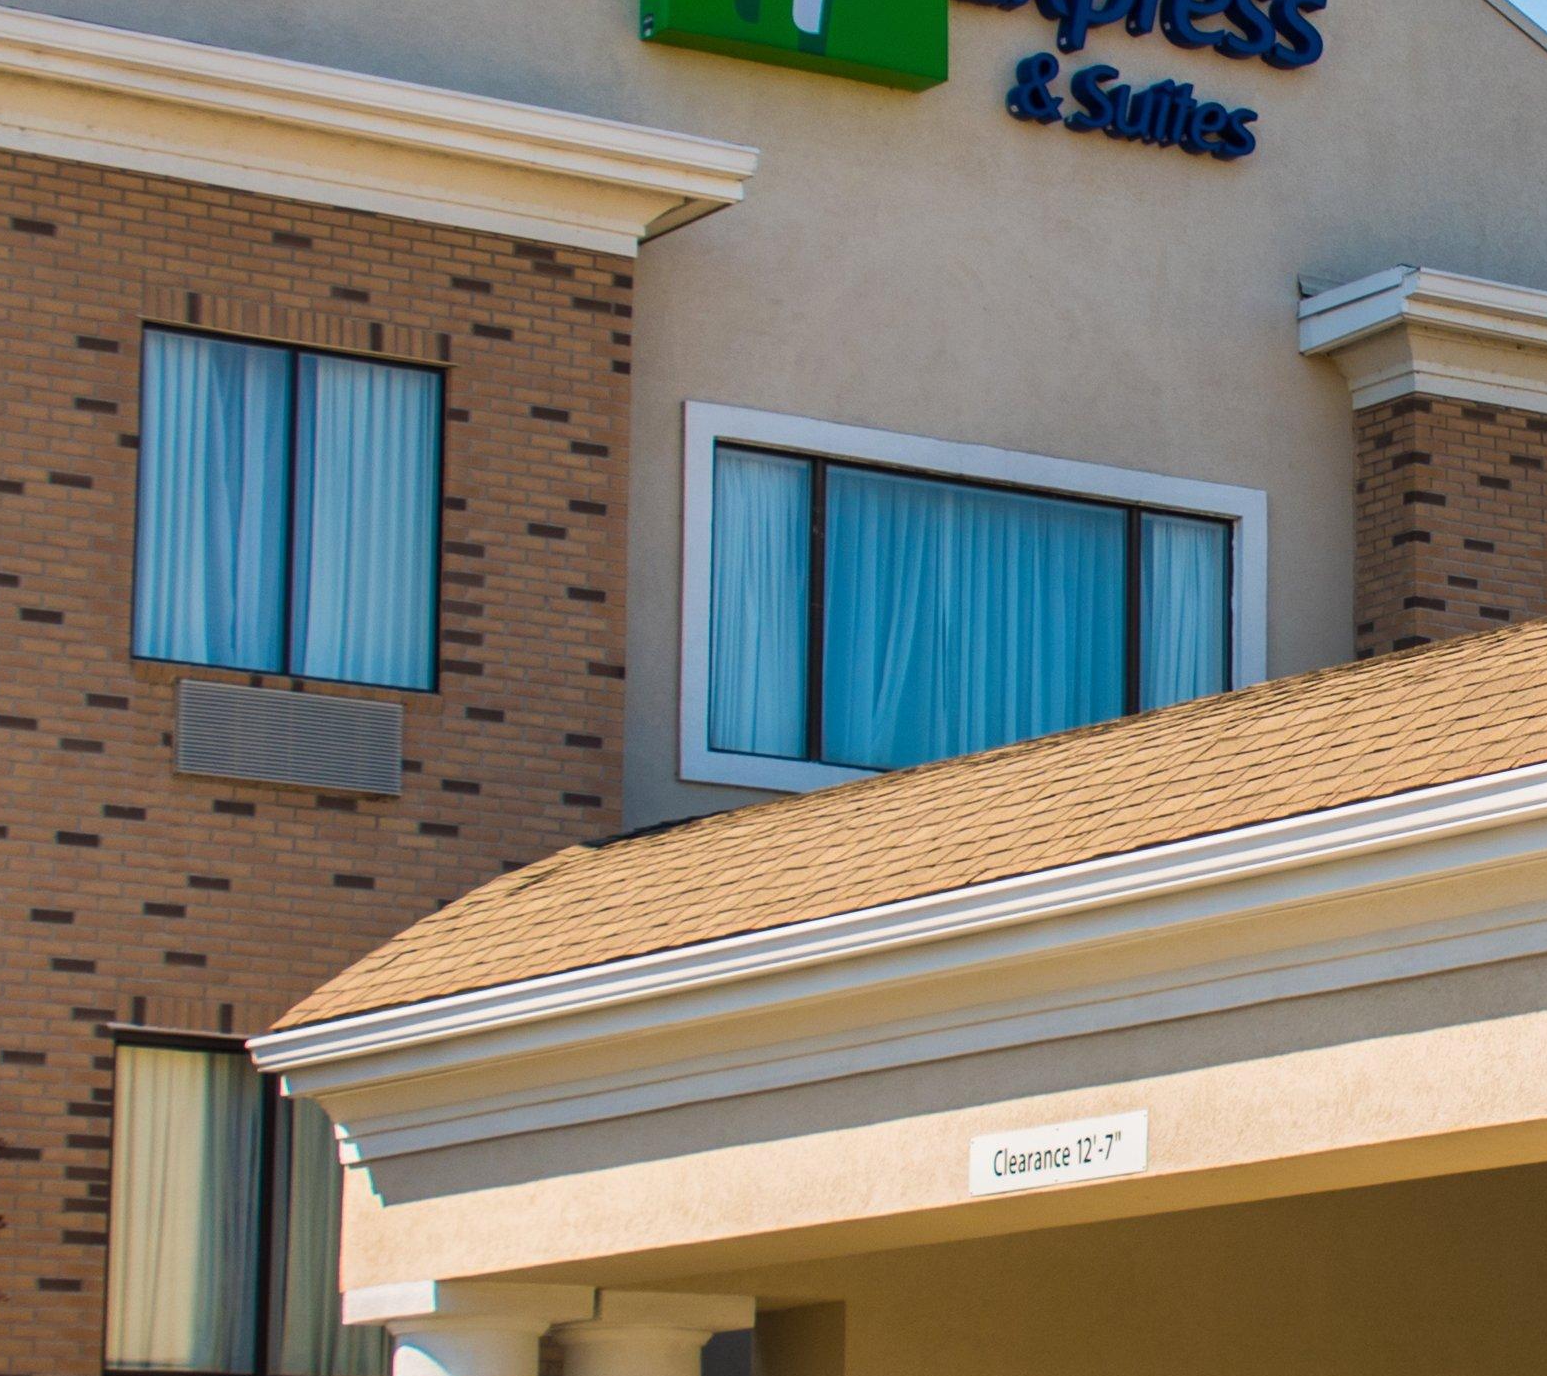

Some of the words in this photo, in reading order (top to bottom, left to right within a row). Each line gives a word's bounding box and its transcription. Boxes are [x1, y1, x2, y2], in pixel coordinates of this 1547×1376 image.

[1005, 52, 1064, 123] &
[1065, 64, 1259, 160] Suites
[993, 1146, 1071, 1177] Clearance
[1076, 1130, 1122, 1164] 12'-7"
